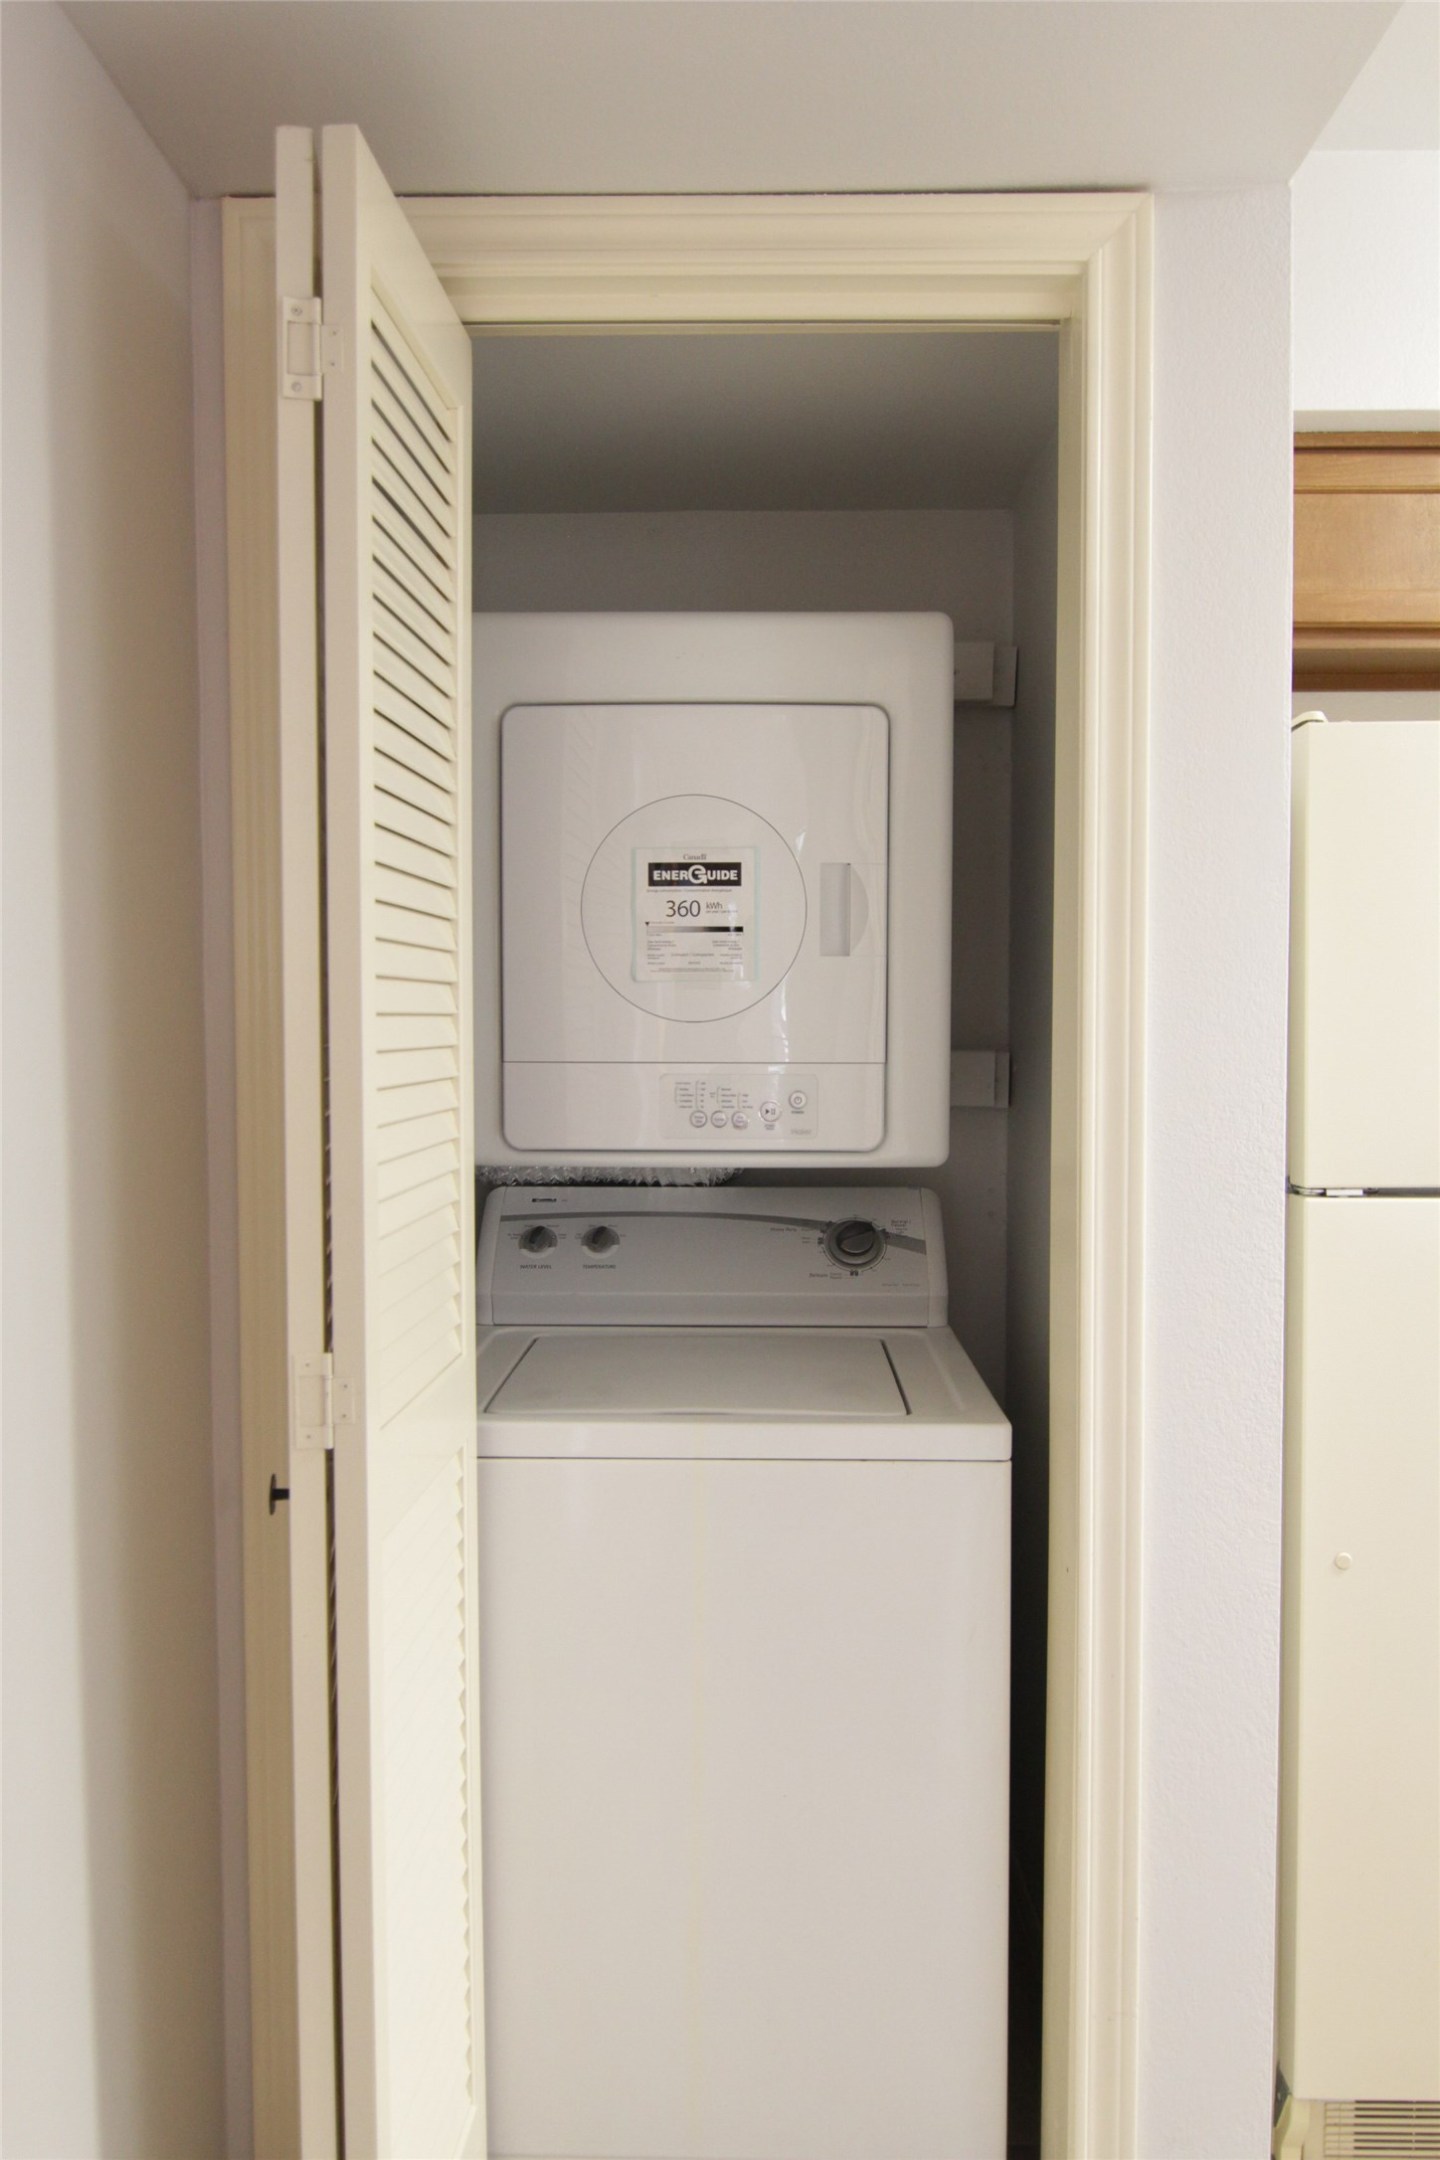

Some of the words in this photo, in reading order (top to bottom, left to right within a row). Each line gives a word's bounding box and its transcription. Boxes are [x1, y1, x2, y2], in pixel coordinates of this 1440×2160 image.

[653, 864, 738, 884] ENERGUIDE
[666, 900, 701, 917] 360
[706, 901, 723, 910] kWh
